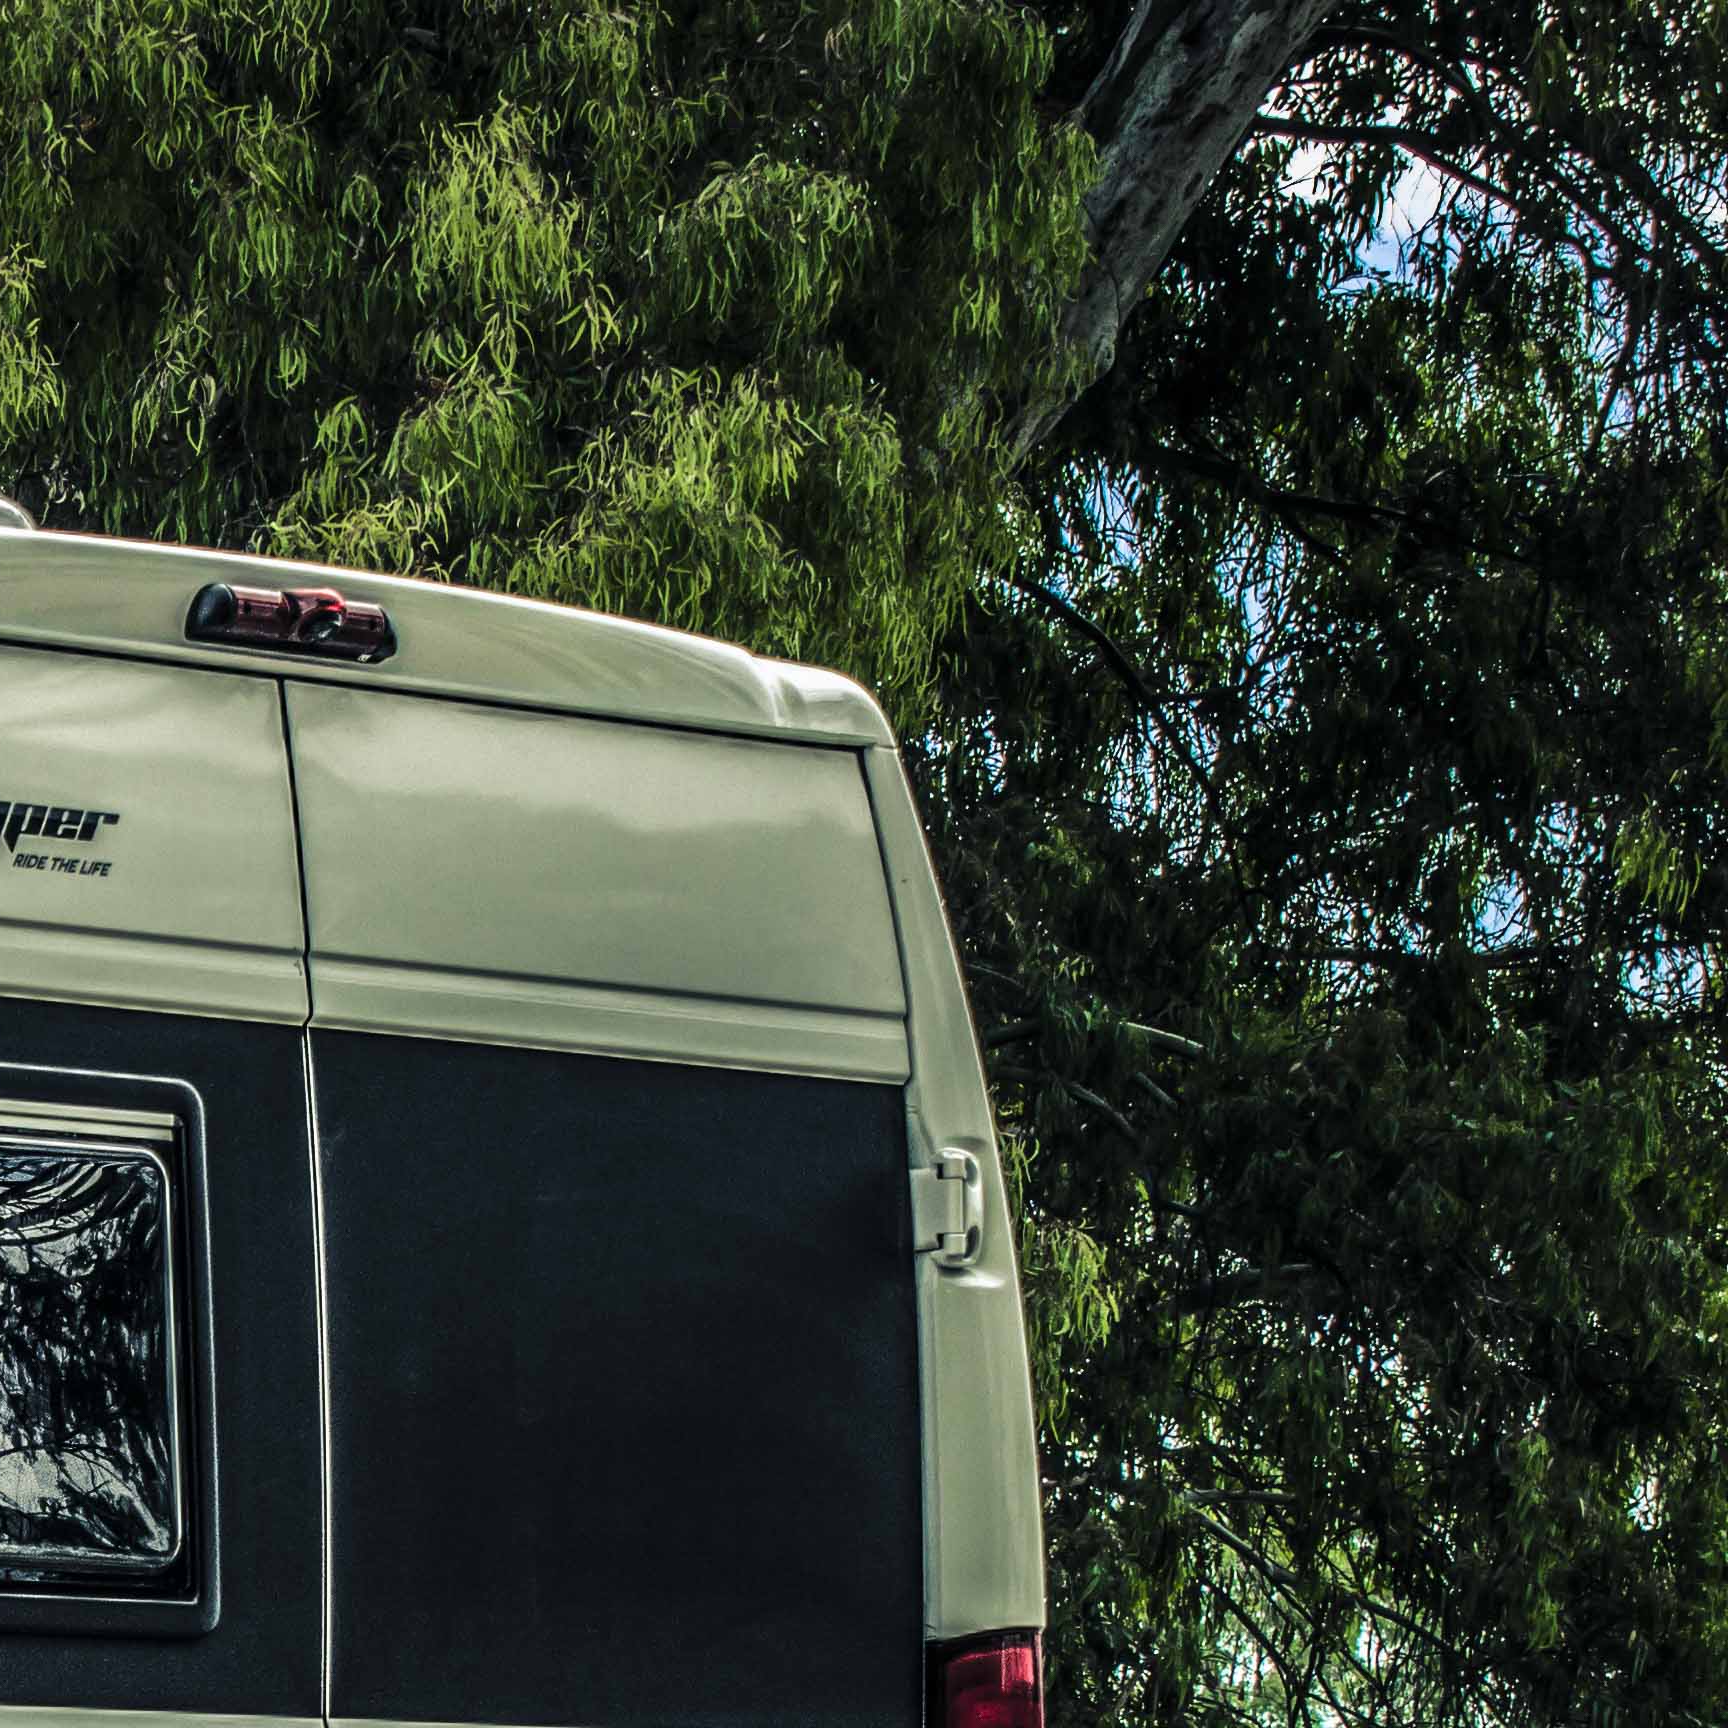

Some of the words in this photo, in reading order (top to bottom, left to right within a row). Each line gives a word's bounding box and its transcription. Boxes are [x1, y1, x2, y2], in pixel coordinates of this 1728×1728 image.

[12, 853, 48, 870] RIDE
[50, 857, 80, 873] THE
[79, 860, 113, 877] LIFE
